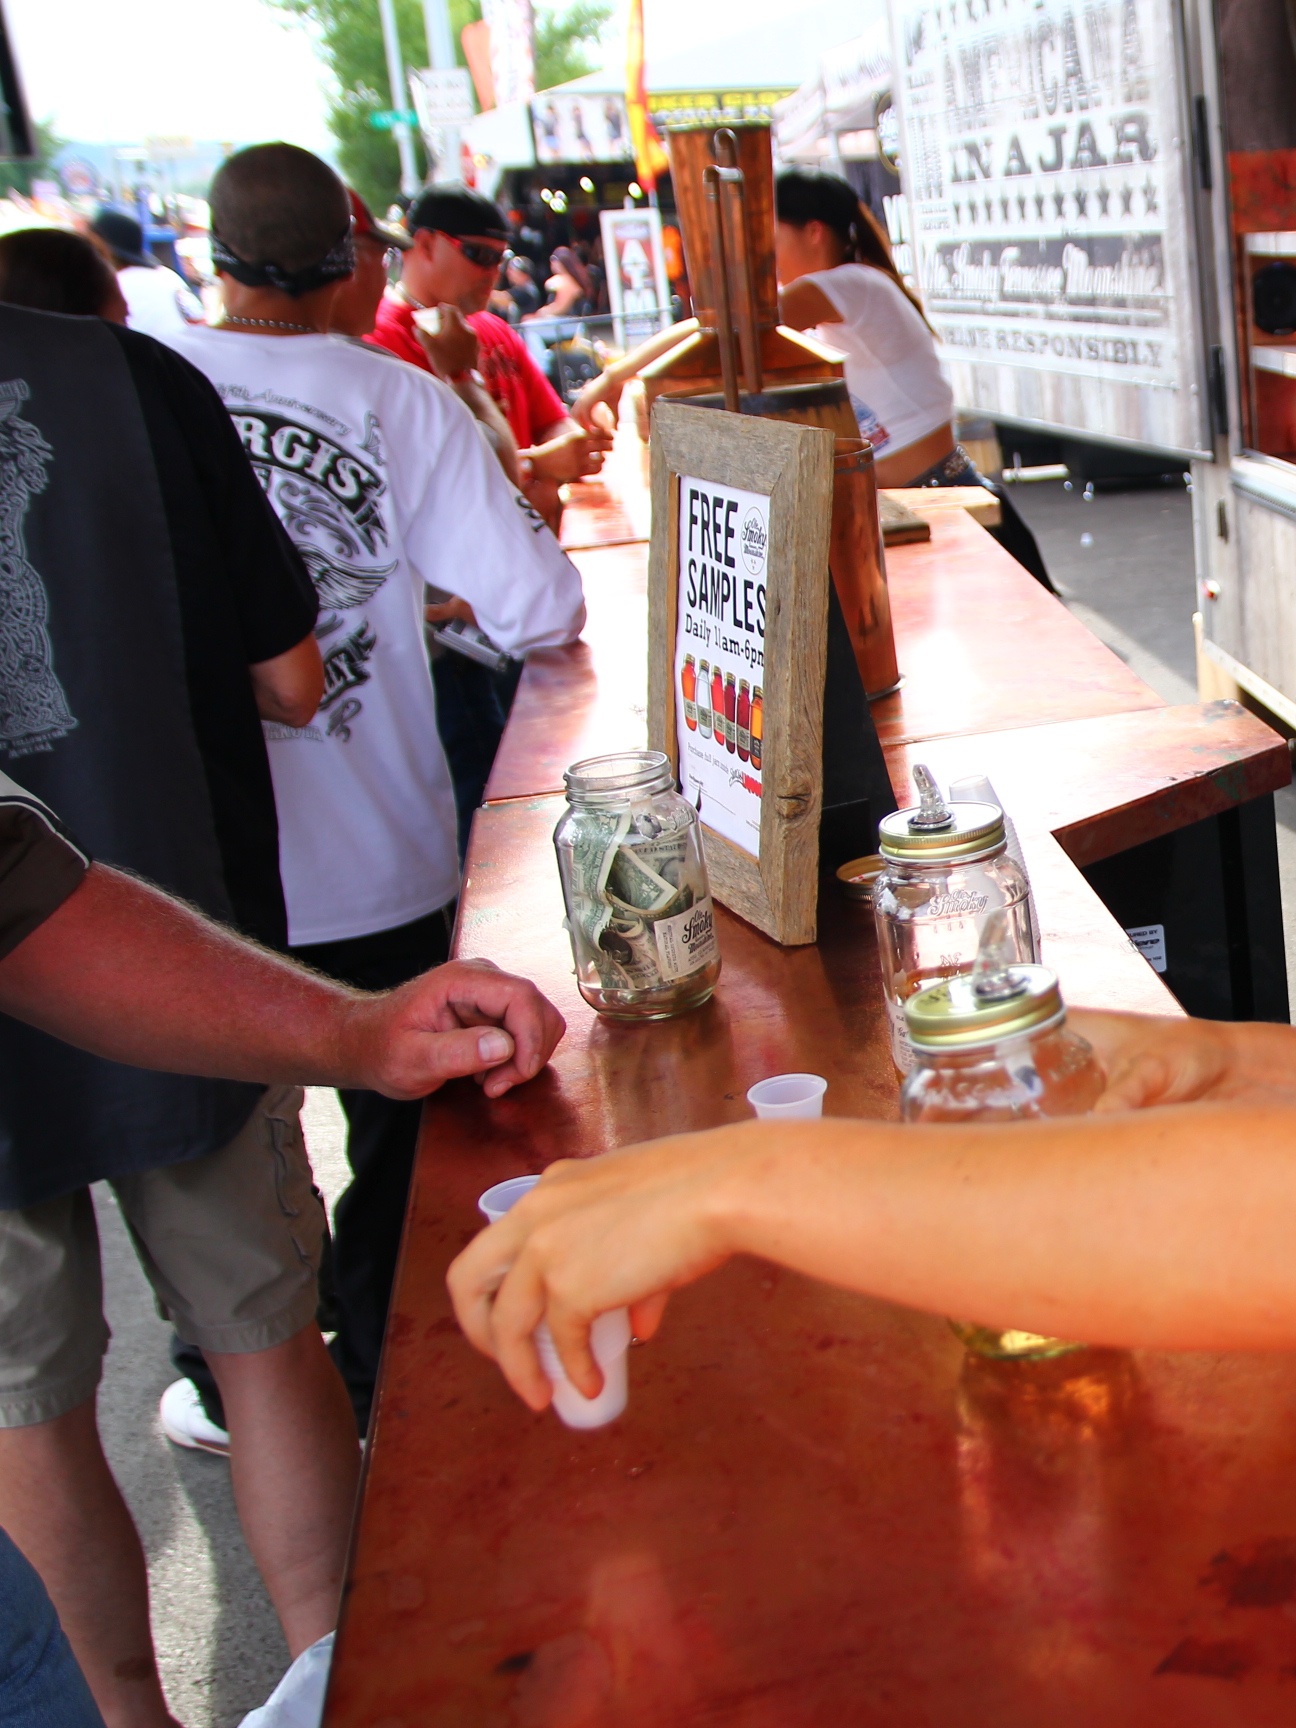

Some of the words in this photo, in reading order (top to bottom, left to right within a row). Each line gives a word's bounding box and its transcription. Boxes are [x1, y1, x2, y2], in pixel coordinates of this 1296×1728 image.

[949, 136, 993, 184] IN
[1004, 132, 1033, 177] A
[1038, 110, 1160, 173] JAR
[996, 329, 1163, 368] RESPONSIBLY
[688, 488, 739, 568] FREE
[687, 558, 767, 639] SAMPLES
[685, 613, 712, 648] Daily
[682, 910, 713, 944] Smoky
